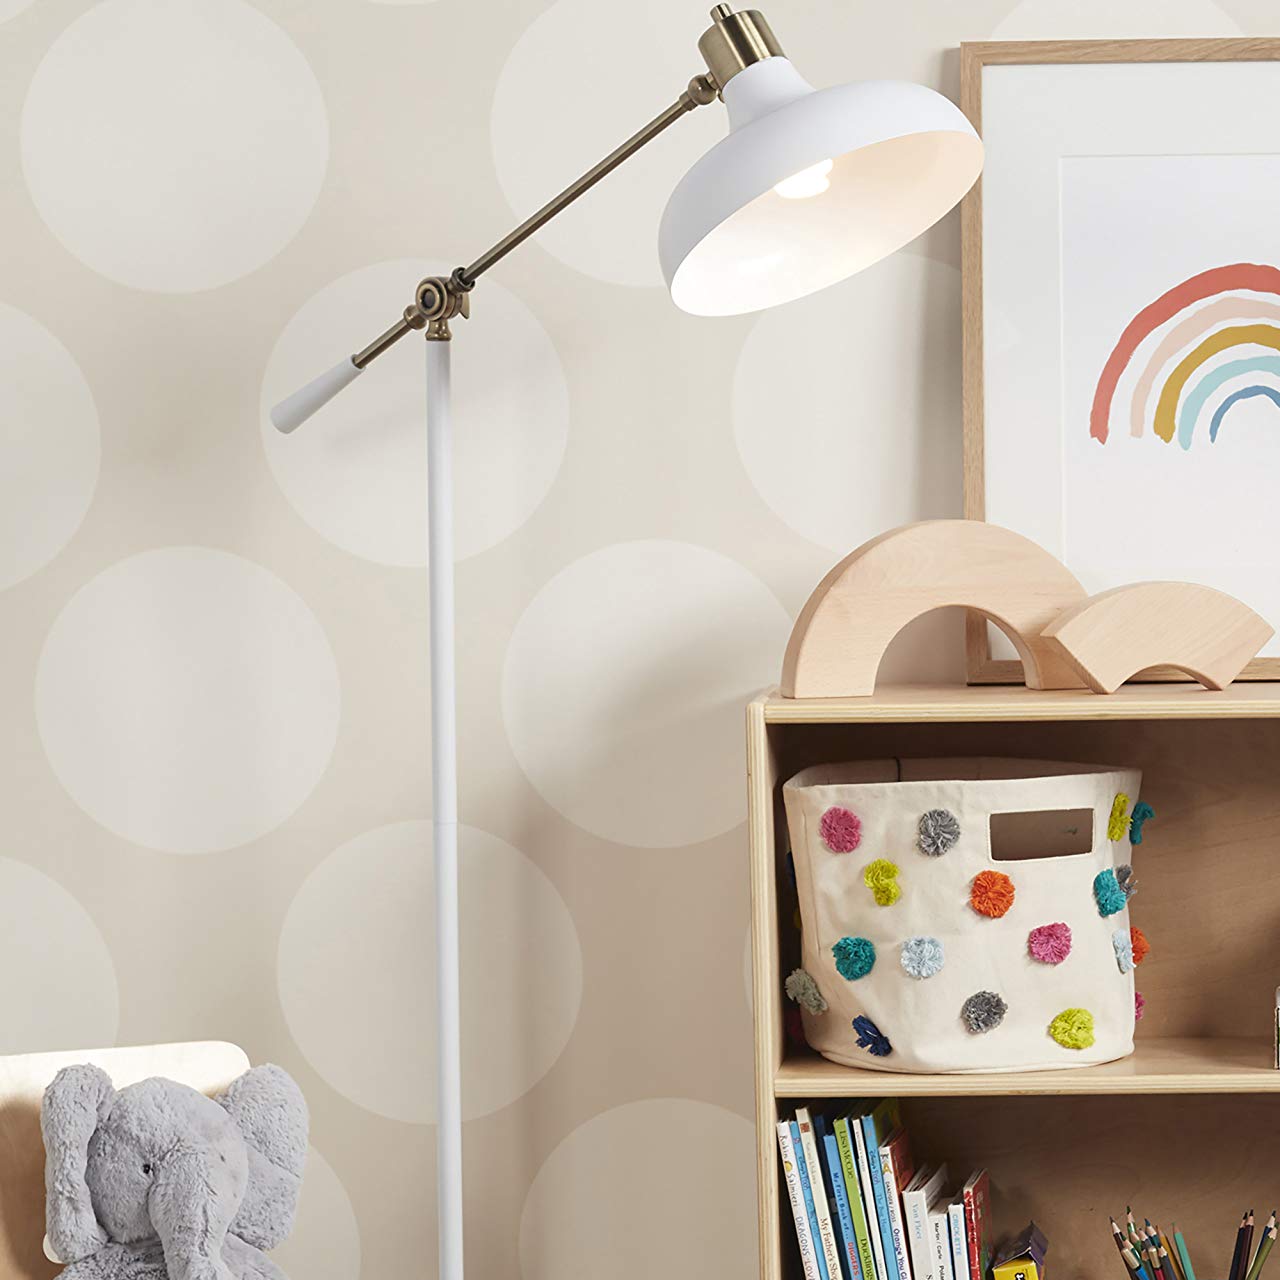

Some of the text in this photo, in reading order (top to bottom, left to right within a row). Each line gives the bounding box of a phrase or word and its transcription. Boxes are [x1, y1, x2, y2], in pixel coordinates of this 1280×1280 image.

[838, 1130, 849, 1149] Lisa
[842, 1148, 855, 1179] McCue
[832, 1172, 840, 1182] My
[779, 1135, 790, 1158] Rubin
[786, 1172, 801, 1207] Salmieri
[795, 1215, 810, 1256] DRAGONS
[835, 1184, 843, 1198] First
[838, 1203, 847, 1220] Book
[911, 1203, 919, 1218] Van
[818, 1217, 830, 1232] My
[822, 1232, 836, 1261] Father's
[846, 1241, 859, 1275] DIGGERS
[890, 1227, 903, 1255] Orange
[897, 1256, 905, 1270] You
[933, 1222, 941, 1241] Martin
[938, 1264, 946, 1280] Polar
